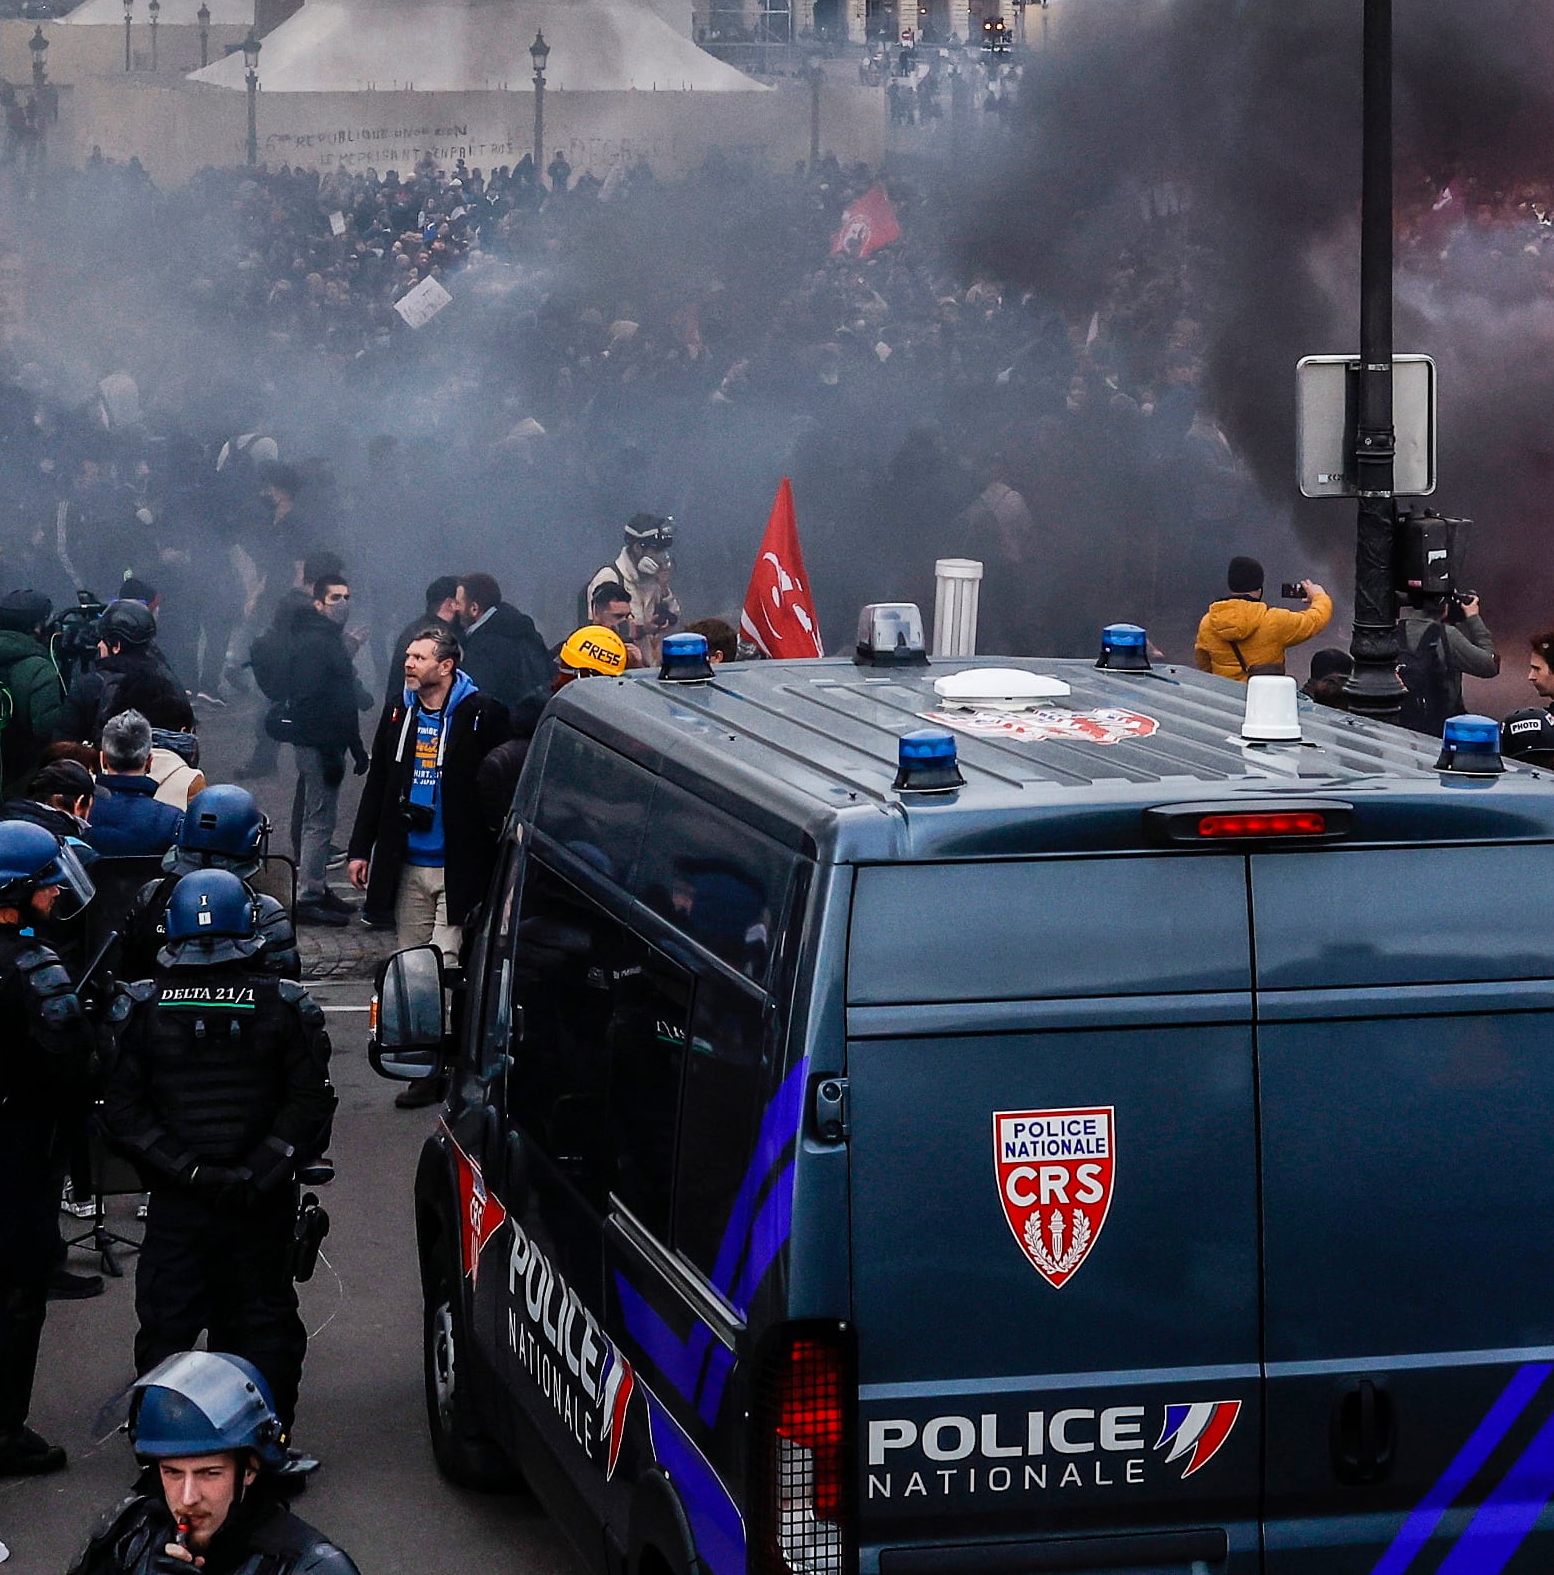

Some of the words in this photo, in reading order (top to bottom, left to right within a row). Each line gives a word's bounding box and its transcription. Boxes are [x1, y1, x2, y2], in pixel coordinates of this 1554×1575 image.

[578, 639, 621, 667] PRESS
[1512, 721, 1539, 732] PHOTO
[161, 987, 211, 1001] DELTA
[215, 986, 255, 1004] 21/1
[1013, 1119, 1097, 1140] POLICE
[1005, 1137, 1106, 1159] NATIONALE
[1005, 1163, 1104, 1207] CRS
[509, 1216, 601, 1401] POLICE
[508, 1306, 593, 1459] NATIONALE
[868, 1406, 1145, 1466] POLICE
[868, 1458, 1145, 1499] NATIONALE
